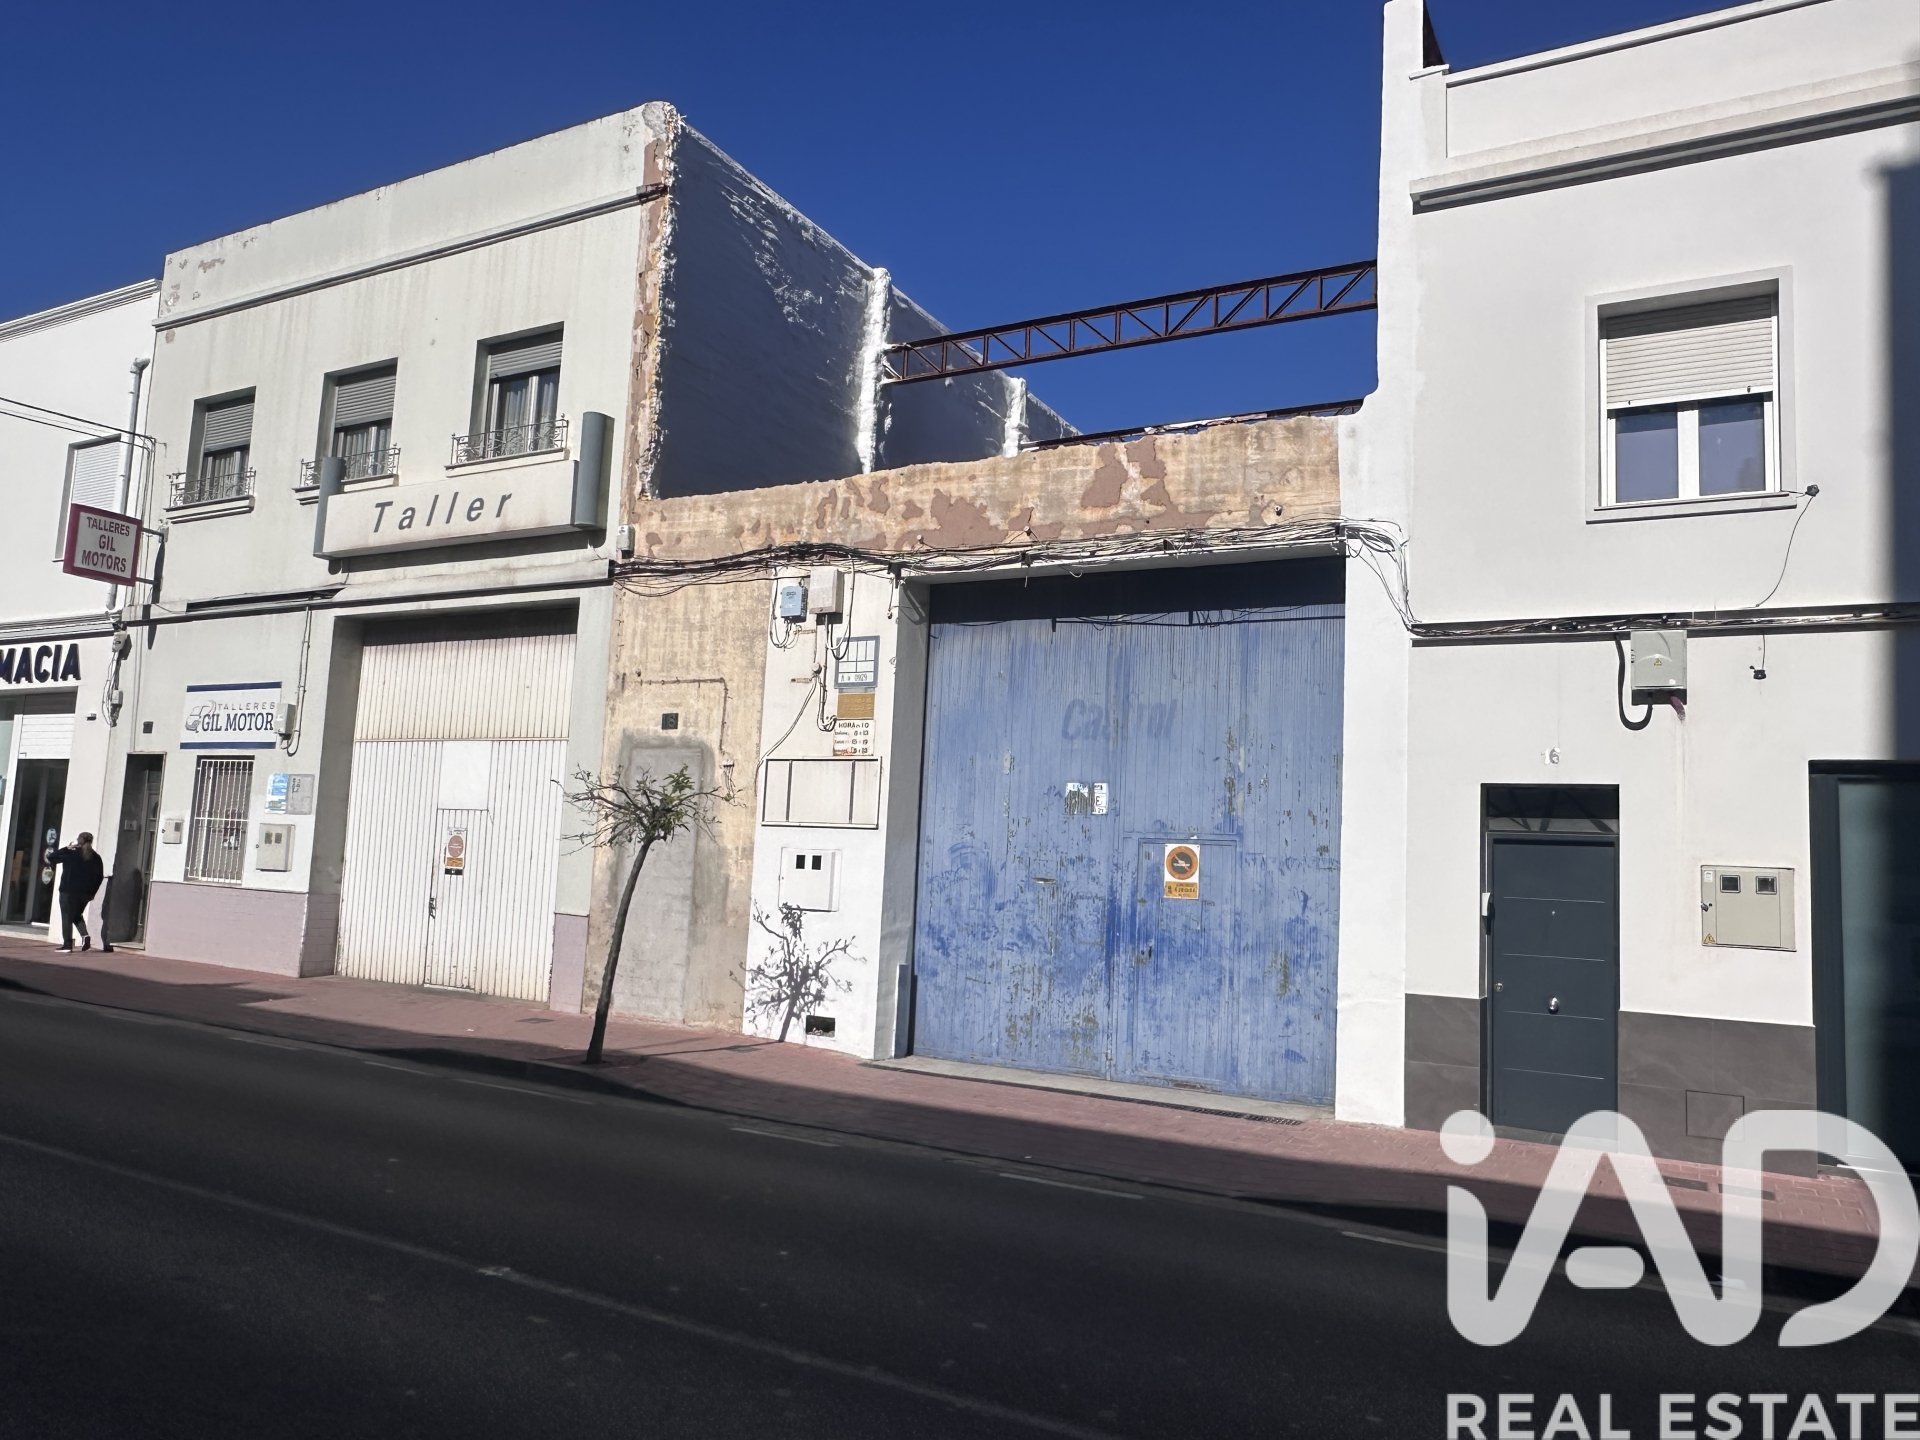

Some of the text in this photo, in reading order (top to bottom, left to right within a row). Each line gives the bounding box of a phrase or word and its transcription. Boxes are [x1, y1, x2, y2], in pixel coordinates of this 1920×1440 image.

[373, 491, 513, 533] Taller
[86, 516, 131, 537] TALLERES
[98, 534, 116, 552] GIL
[81, 549, 127, 573] MOTORS
[218, 701, 276, 711] TALLERES
[201, 712, 223, 732] GIL
